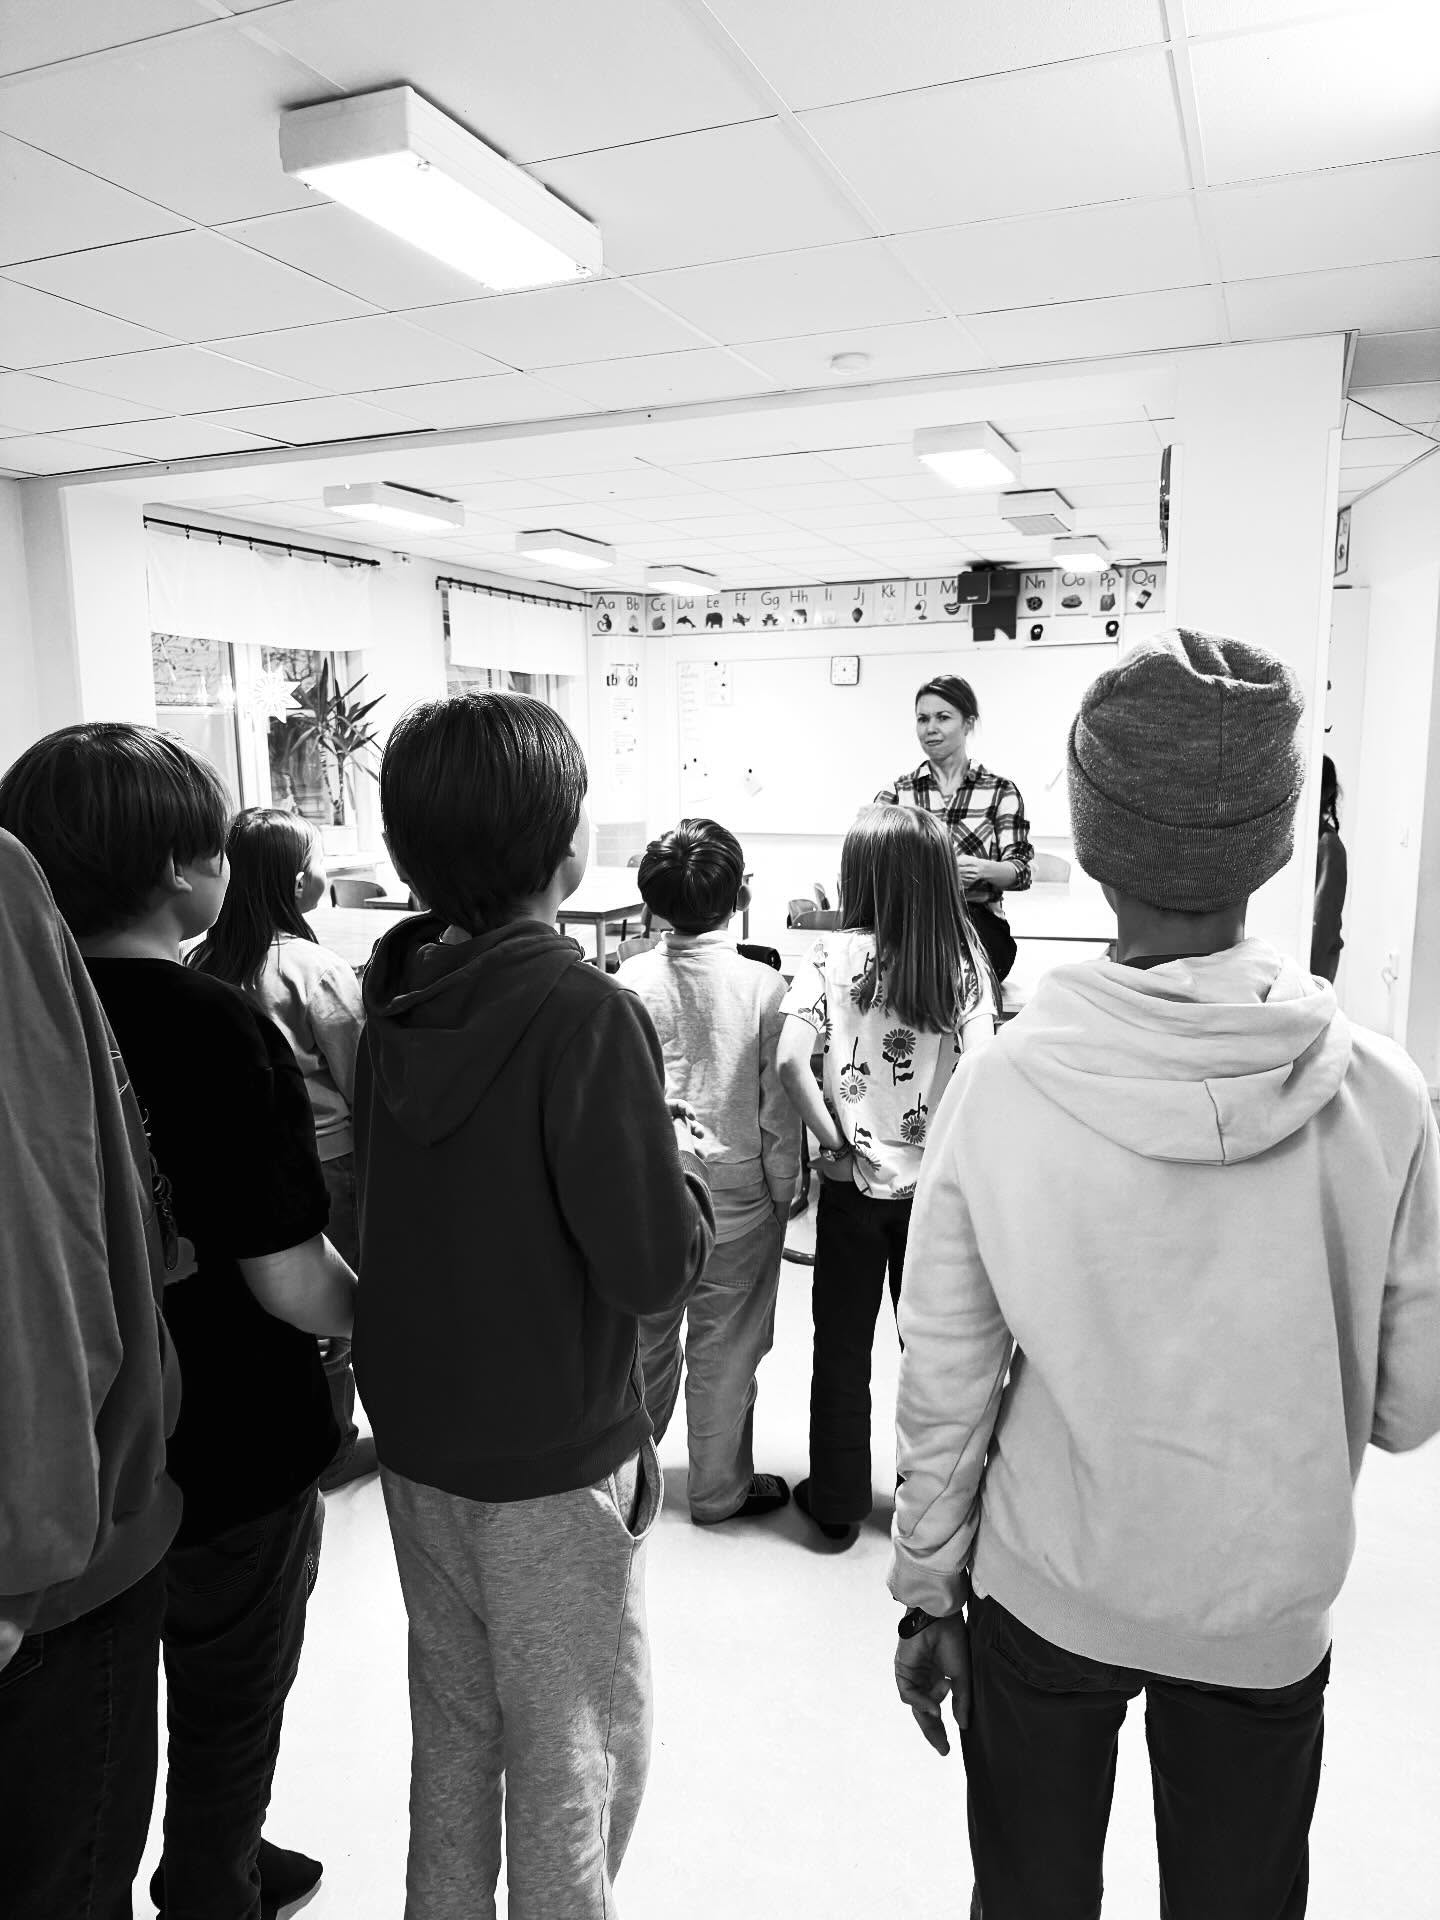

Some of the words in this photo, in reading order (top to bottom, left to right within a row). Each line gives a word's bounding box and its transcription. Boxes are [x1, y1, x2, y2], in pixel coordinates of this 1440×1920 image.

[595, 596, 616, 610] Aa
[626, 596, 640, 611] Bb
[651, 598, 666, 611] Cc
[677, 596, 694, 610] Dd
[706, 595, 720, 608] Ee
[735, 592, 747, 606] Ff
[761, 591, 780, 610] Gg
[790, 589, 809, 603] Hh
[824, 587, 833, 601] Ii
[852, 586, 865, 606] Jj
[881, 584, 896, 598] Kk
[939, 580, 957, 594] M
[1024, 575, 1046, 589] Nn
[1061, 572, 1086, 587] Oo
[1100, 572, 1116, 592] Pp
[1131, 568, 1157, 589] Qq
